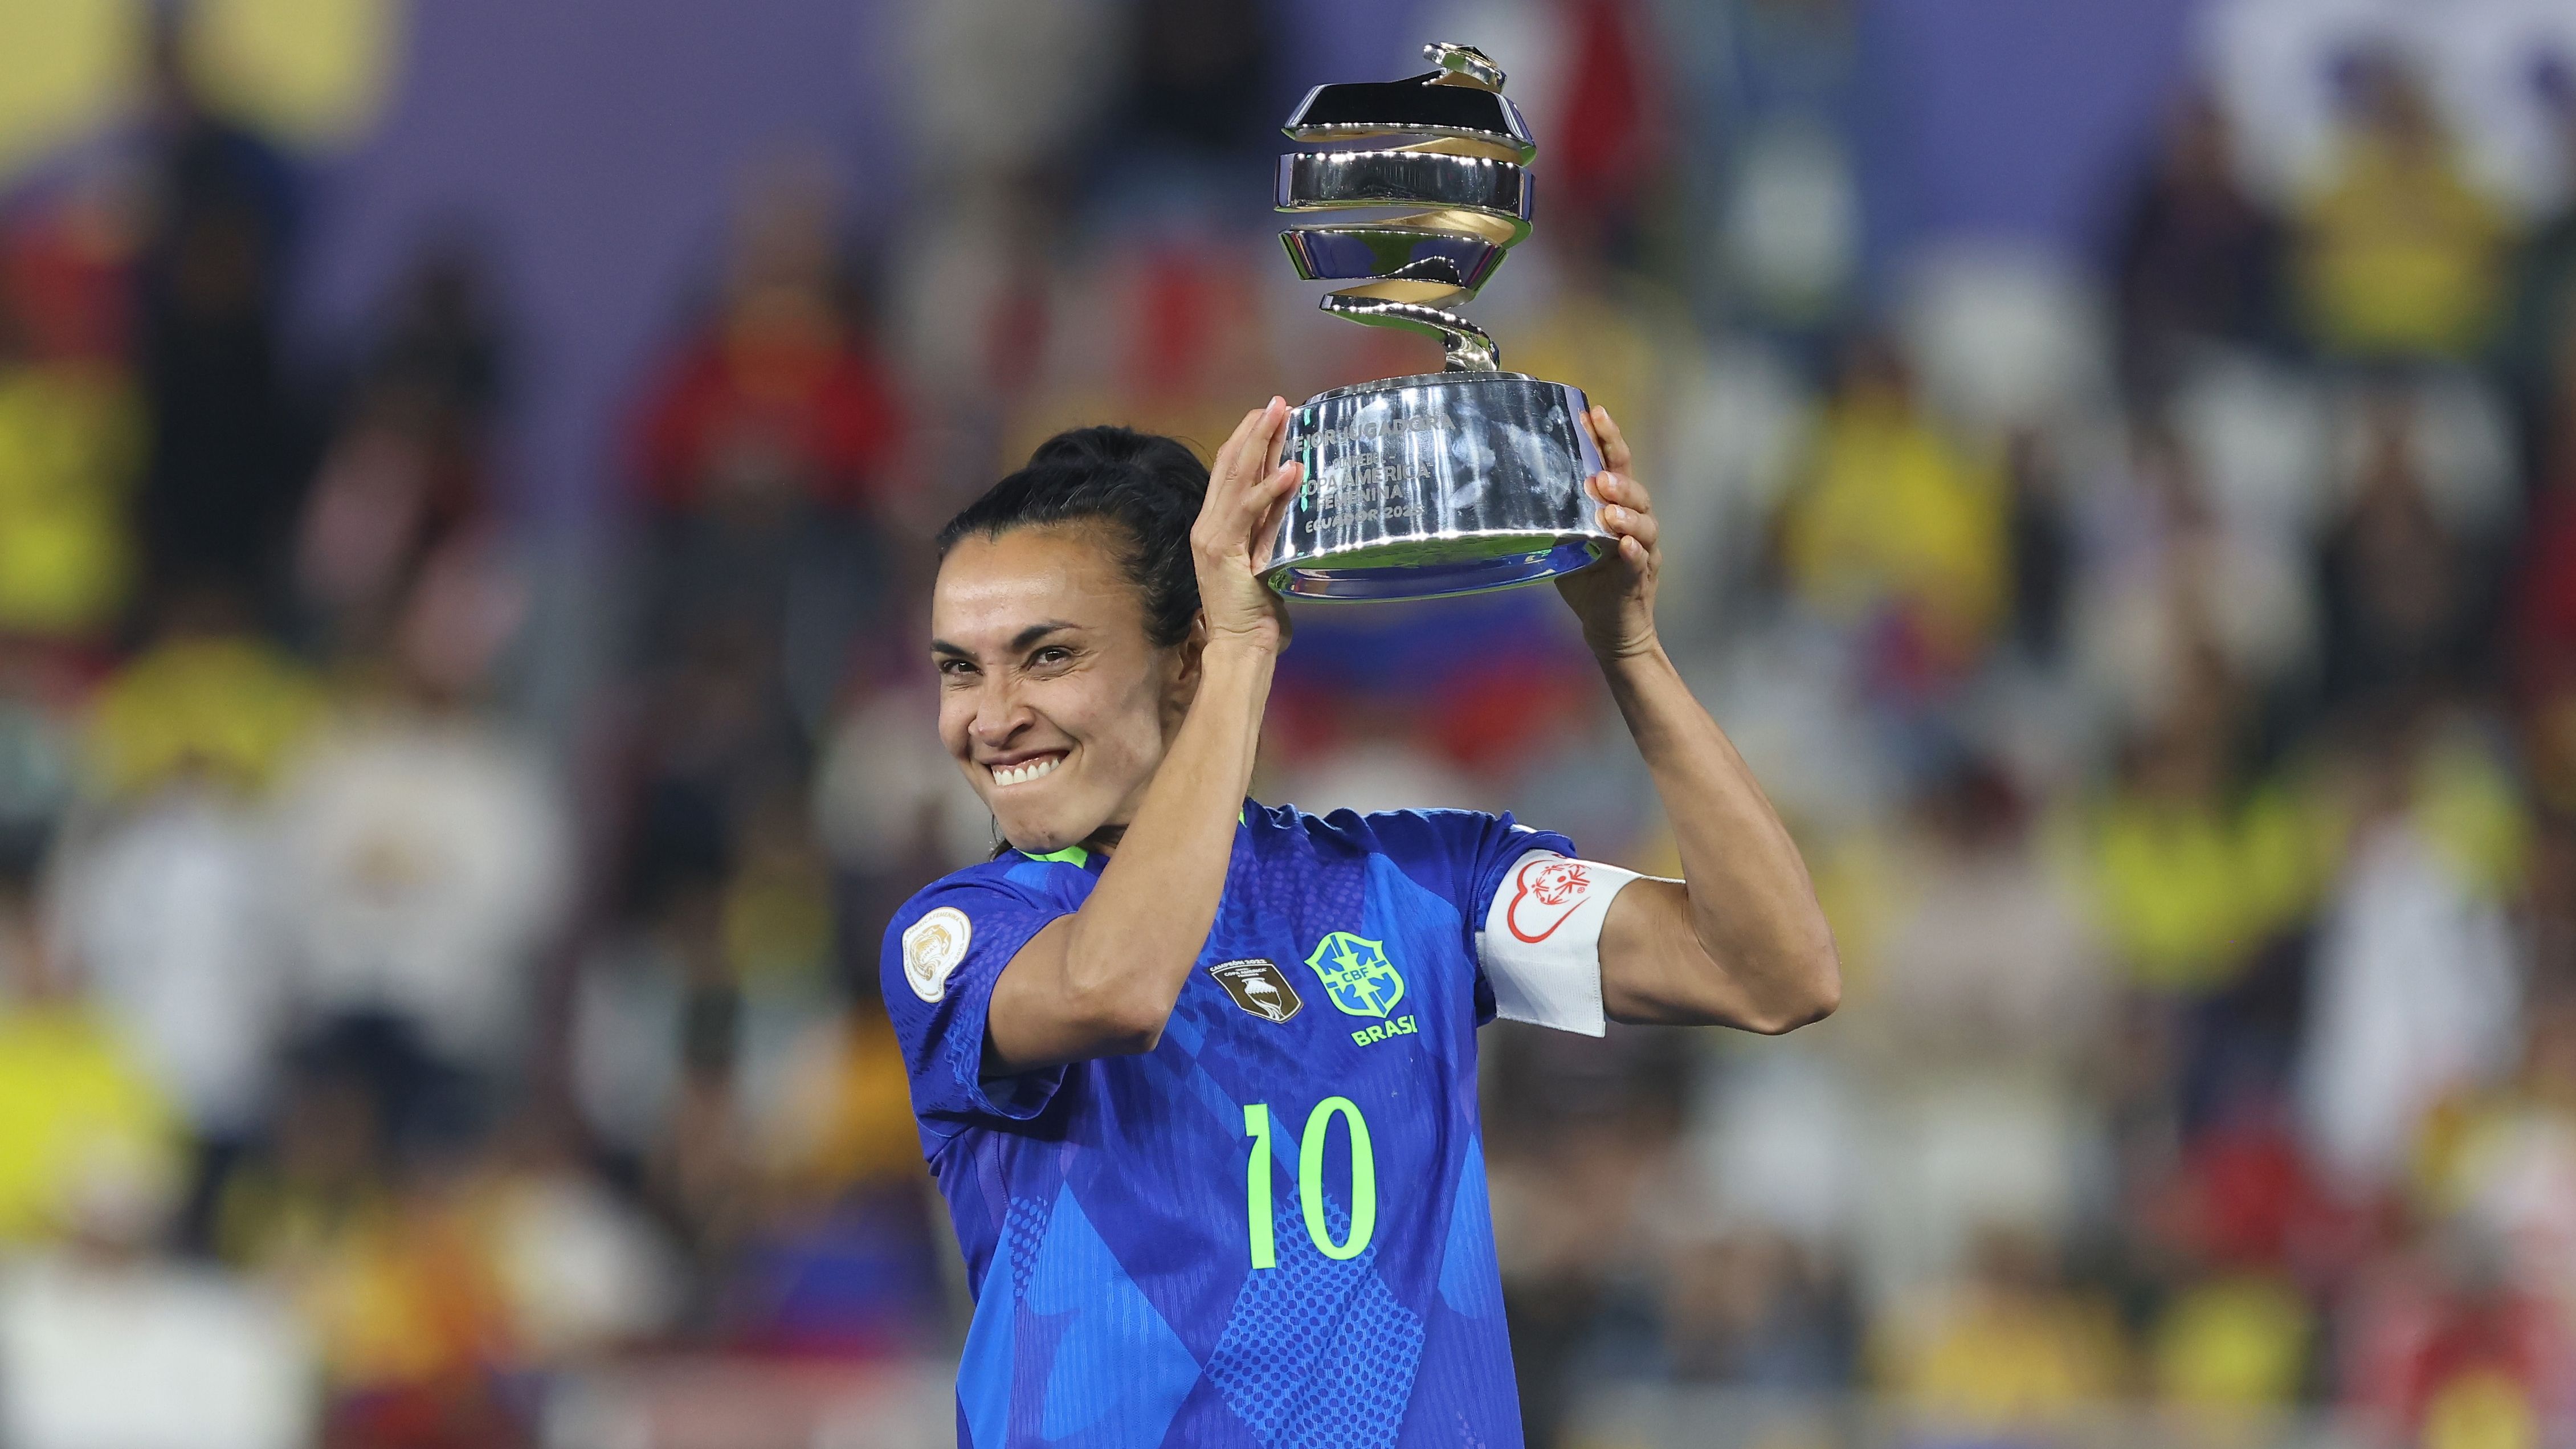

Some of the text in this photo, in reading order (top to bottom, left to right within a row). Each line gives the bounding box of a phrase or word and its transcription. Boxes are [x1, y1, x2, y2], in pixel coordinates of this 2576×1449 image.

[1284, 414, 1456, 456] MEJOR JUGADORA
[1317, 484, 1403, 512] FEMENINA
[1305, 508, 1379, 534] ECUADOR
[1341, 966, 1369, 983] CBF
[1350, 1015, 1418, 1047] BRASI
[1243, 1096, 1377, 1270] 10
